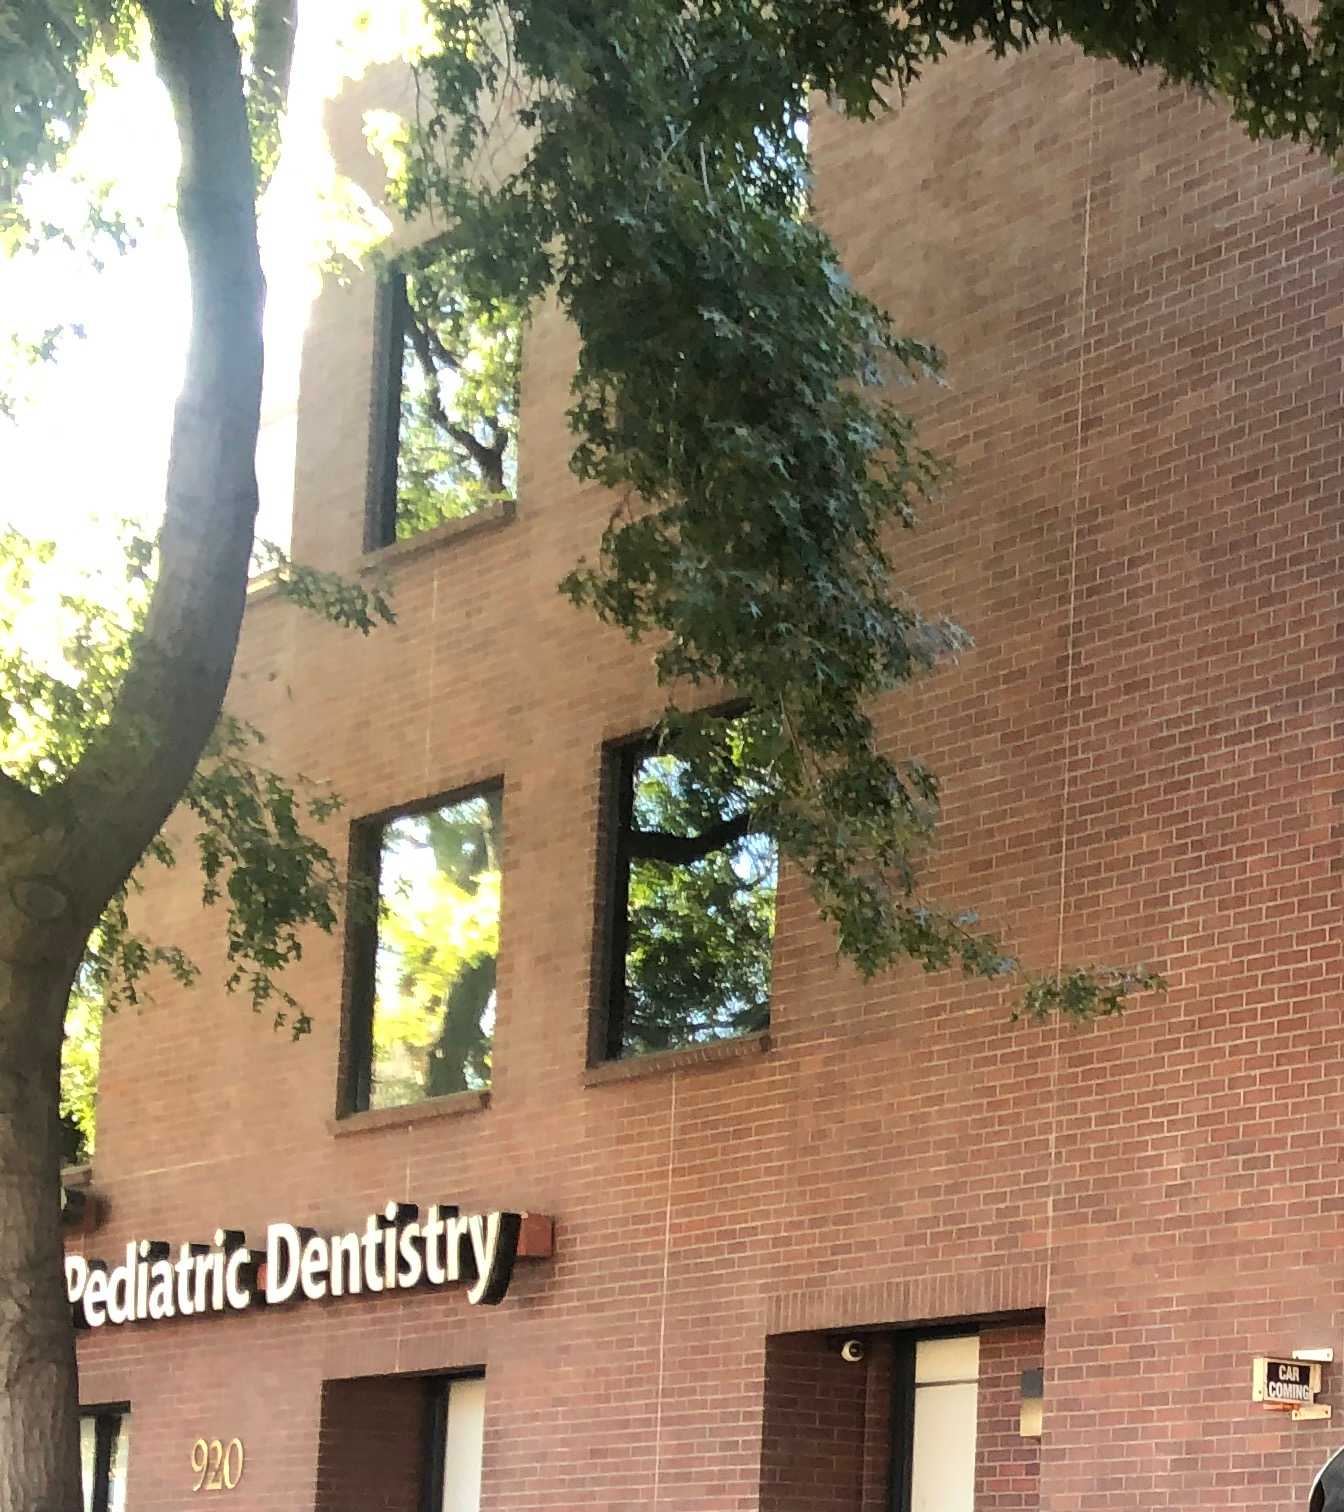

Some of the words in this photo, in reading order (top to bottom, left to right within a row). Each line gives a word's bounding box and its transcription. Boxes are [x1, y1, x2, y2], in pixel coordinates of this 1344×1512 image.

[64, 1228, 252, 1328] Pediatric
[265, 1200, 503, 1306] Dentistry
[1268, 1381, 1310, 1400] COMING
[1278, 1364, 1300, 1382] CAR
[191, 1438, 244, 1491] 920
